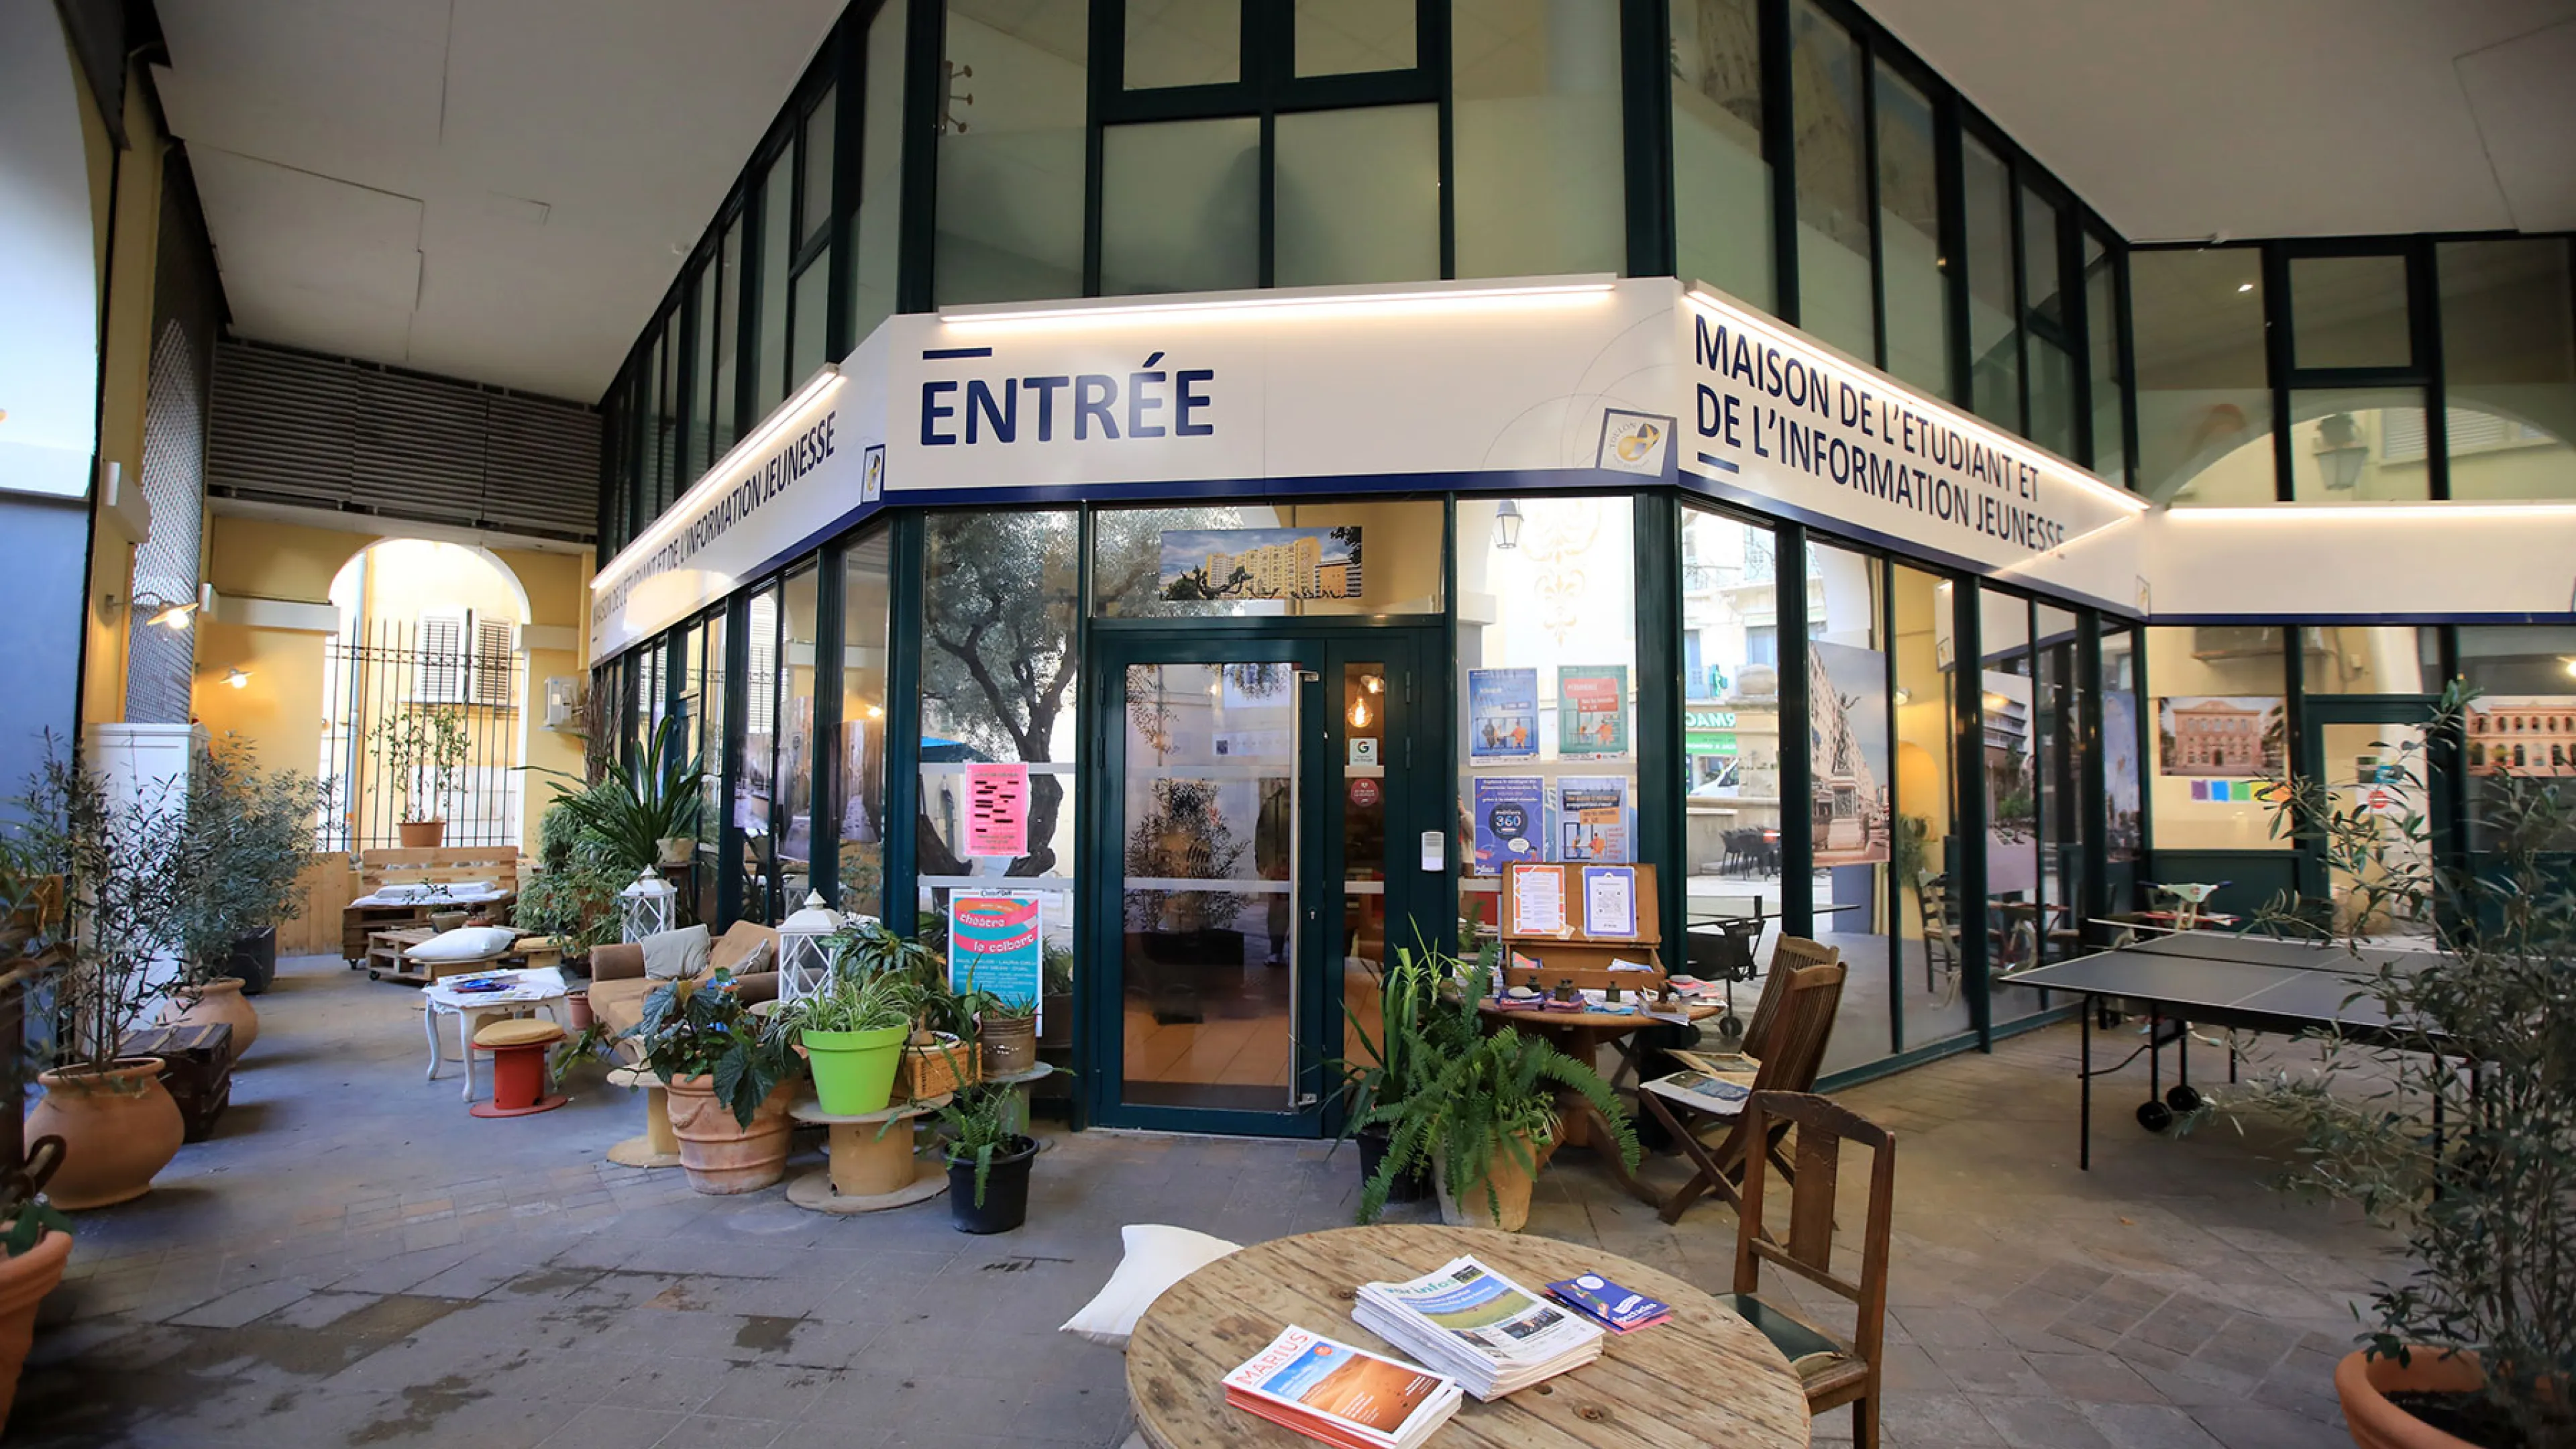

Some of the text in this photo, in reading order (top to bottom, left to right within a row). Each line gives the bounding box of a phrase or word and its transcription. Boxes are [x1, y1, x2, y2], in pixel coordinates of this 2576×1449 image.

[920, 352, 1214, 445] ENTRÉE
[1695, 313, 1829, 419] MAISON
[1839, 382, 1874, 437] DE
[2019, 462, 2039, 502] ET
[680, 474, 761, 564] L'INFORMATION
[763, 411, 836, 502] JEUNESSE
[1697, 383, 2065, 558] DE L'INFORMATION JEUNESSE
[1496, 816, 1521, 826] 360
[1234, 1332, 1309, 1385] MARIUS
